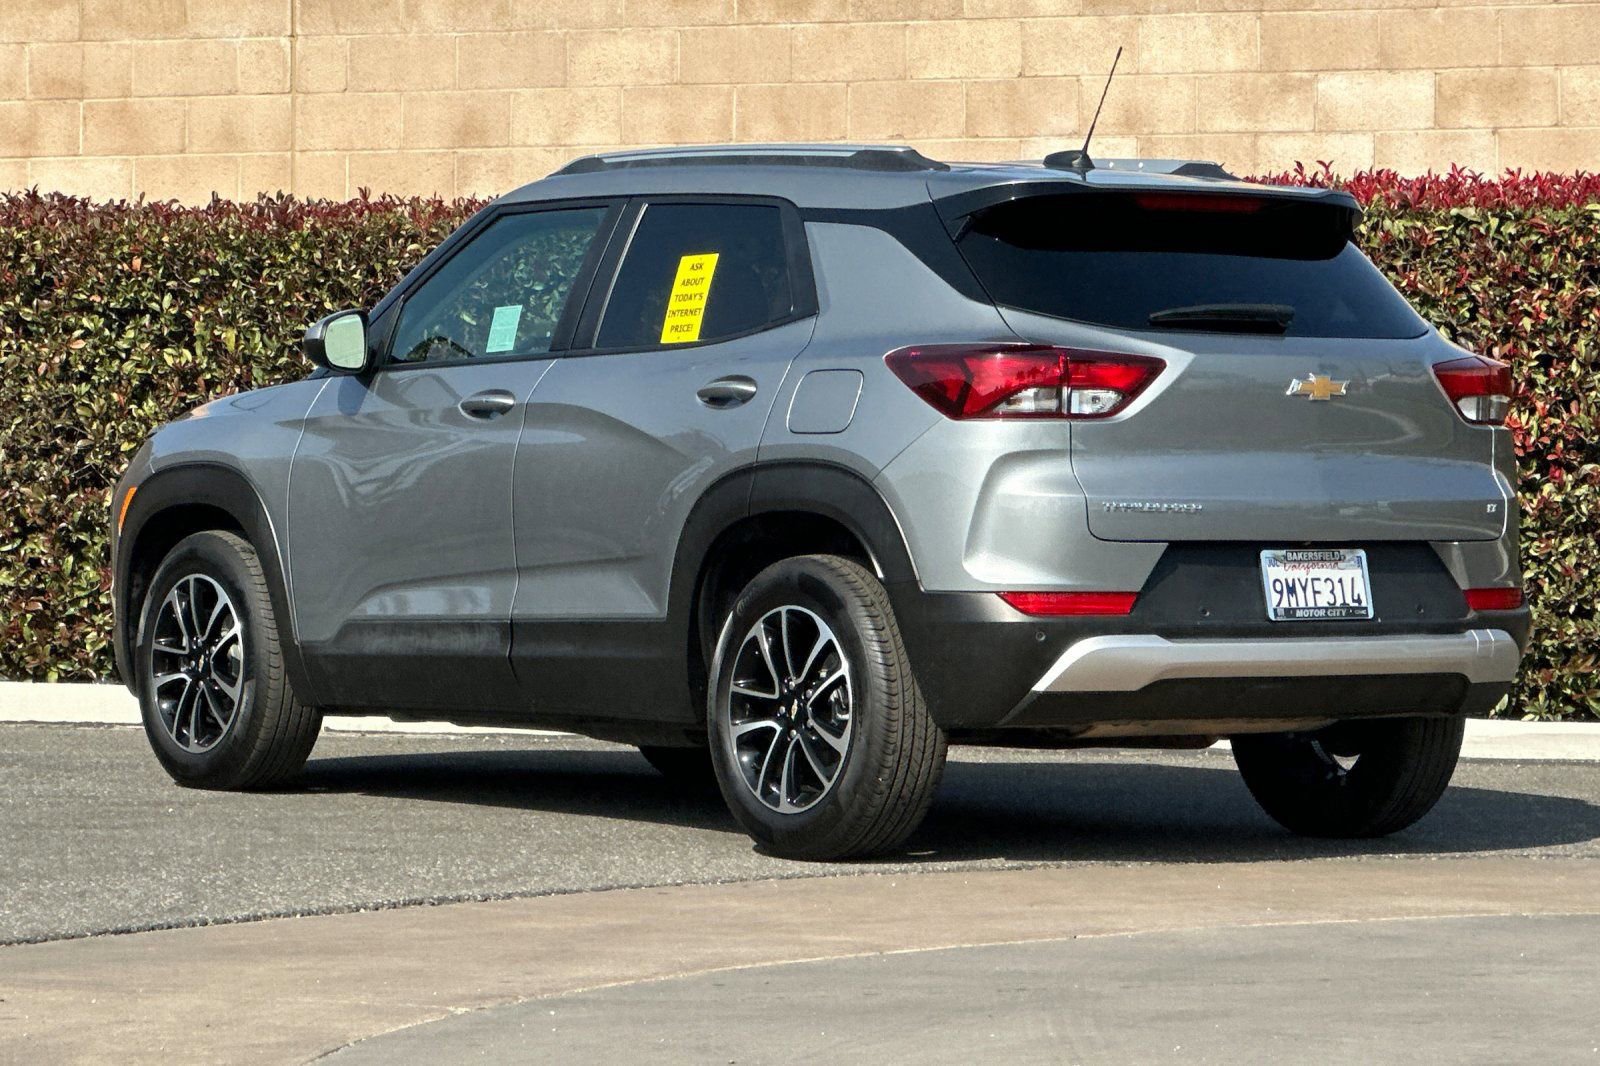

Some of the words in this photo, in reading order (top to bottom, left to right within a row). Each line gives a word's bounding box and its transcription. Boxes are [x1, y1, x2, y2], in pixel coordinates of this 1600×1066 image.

[690, 263, 704, 271] ASK
[681, 277, 705, 287] ABOUT
[675, 292, 704, 303] TODAY'S
[668, 308, 702, 318] INTERNET
[670, 323, 694, 333] PRICE!
[1286, 551, 1340, 561] BAKERSFIELD
[1272, 577, 1363, 608] 9MYF314
[1295, 609, 1326, 618] MOTOR
[1327, 608, 1347, 617] CITY
